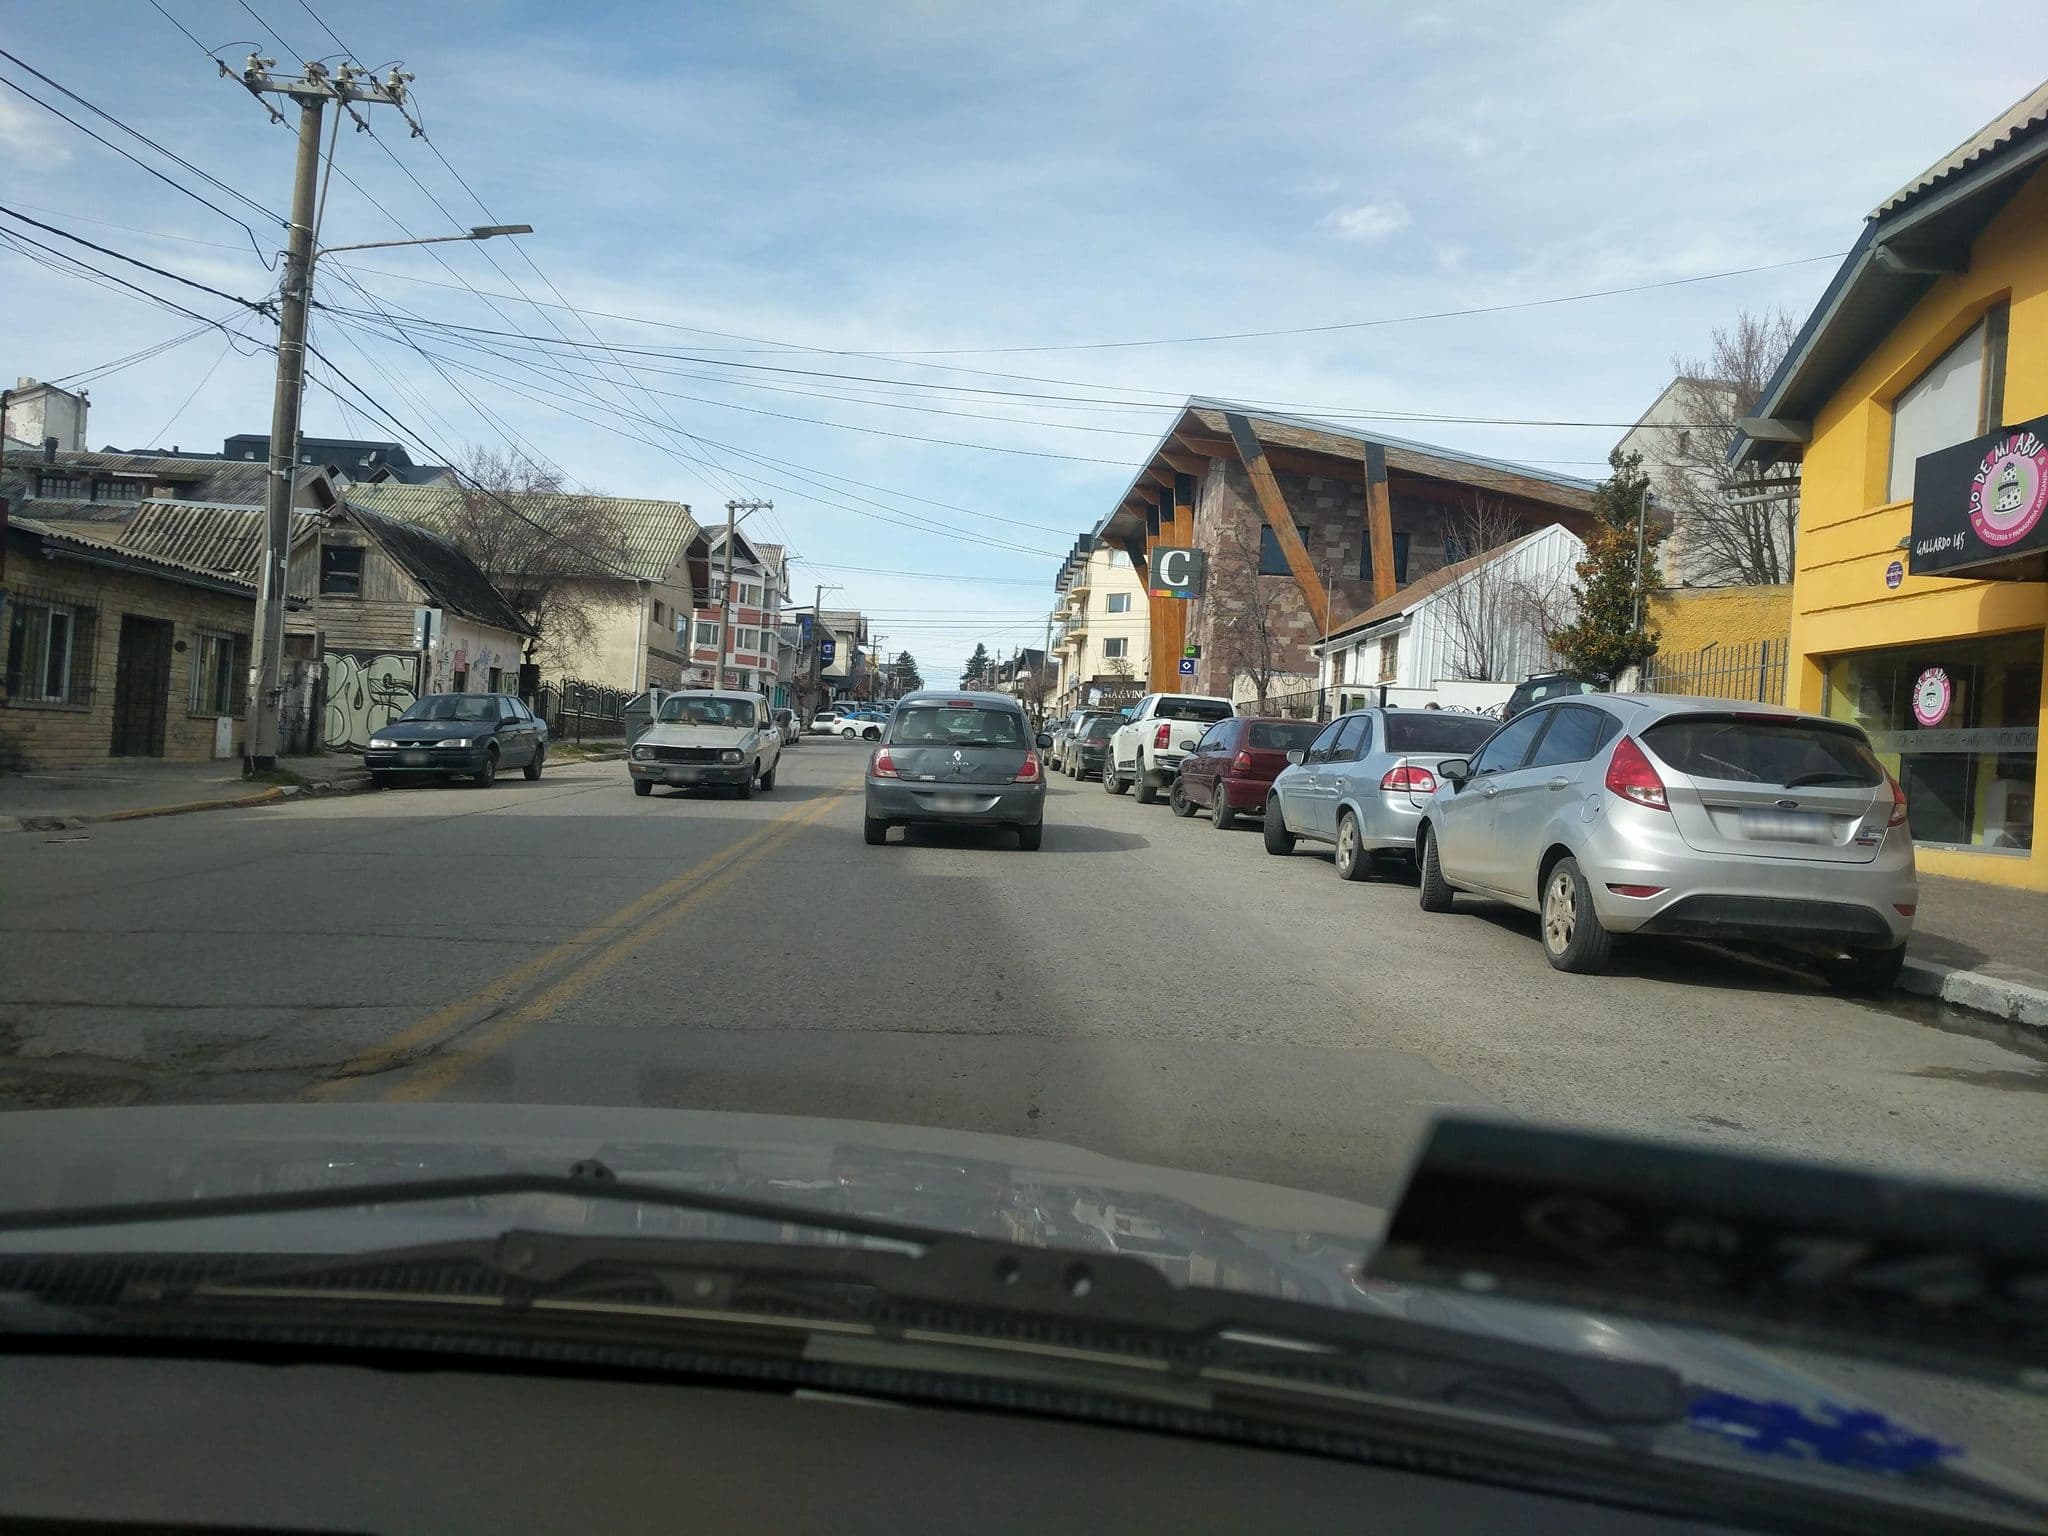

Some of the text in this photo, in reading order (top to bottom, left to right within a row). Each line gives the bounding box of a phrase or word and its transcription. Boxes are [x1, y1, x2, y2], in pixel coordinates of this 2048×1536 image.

[1968, 432, 2044, 514] LO DE MI ABU
[1917, 531, 1966, 556] GALLARDO 145
[1160, 549, 1190, 587] C
